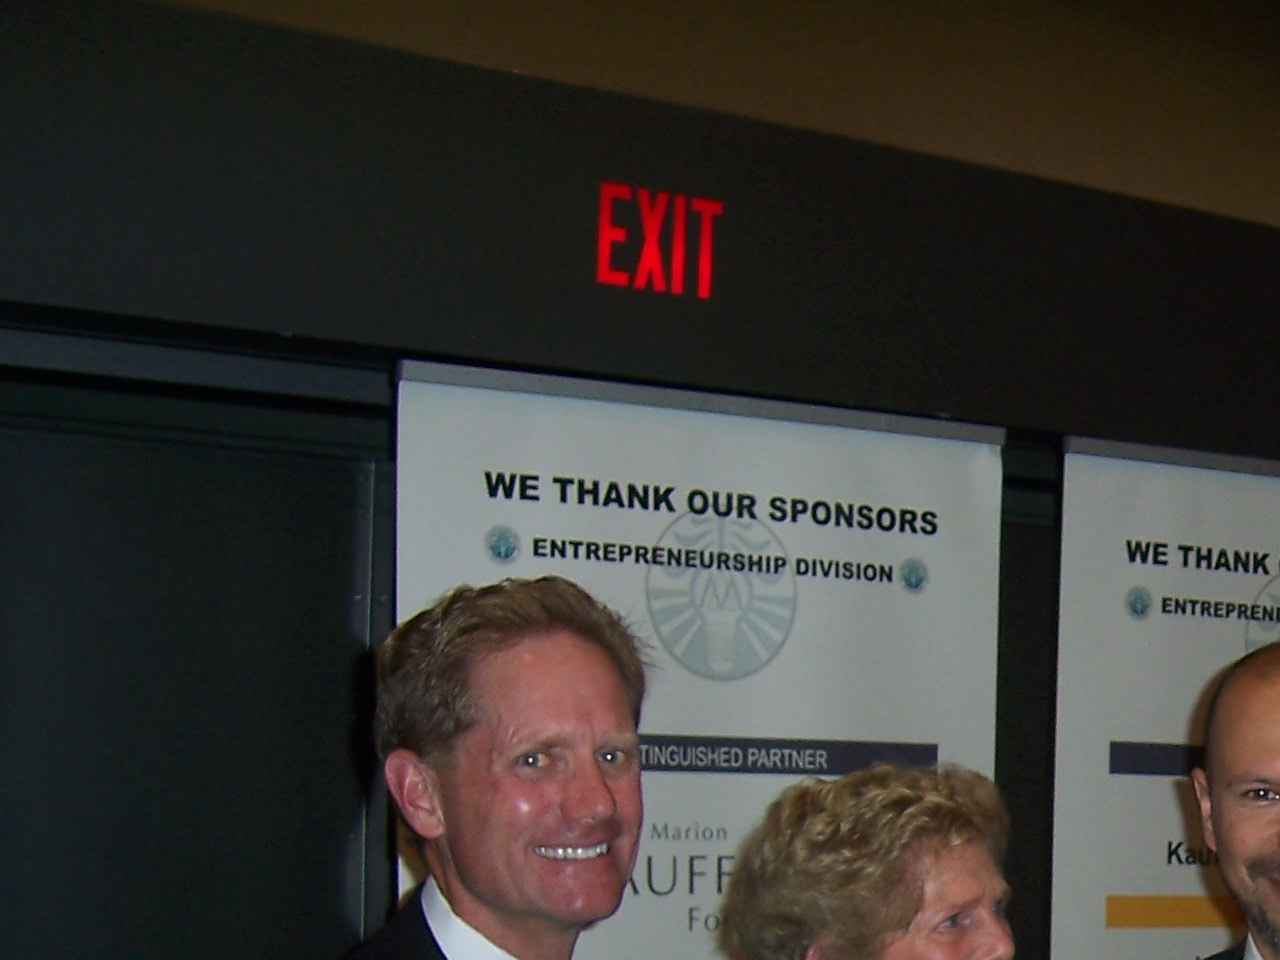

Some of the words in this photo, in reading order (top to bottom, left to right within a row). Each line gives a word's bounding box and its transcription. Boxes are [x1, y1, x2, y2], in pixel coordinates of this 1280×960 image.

[598, 178, 725, 300] EXIT
[484, 471, 540, 501] WE
[552, 476, 678, 513] THANK
[687, 488, 757, 520] OUR
[768, 496, 939, 535] SPONSORS
[532, 537, 787, 575] ENTREPRENEURSHIP
[795, 557, 894, 583] DIVISION
[1126, 539, 1169, 566] WE
[1178, 544, 1270, 576] THANK
[638, 744, 743, 768] TINGUISHED
[747, 748, 828, 769] PARTNER
[651, 822, 727, 841] Marion
